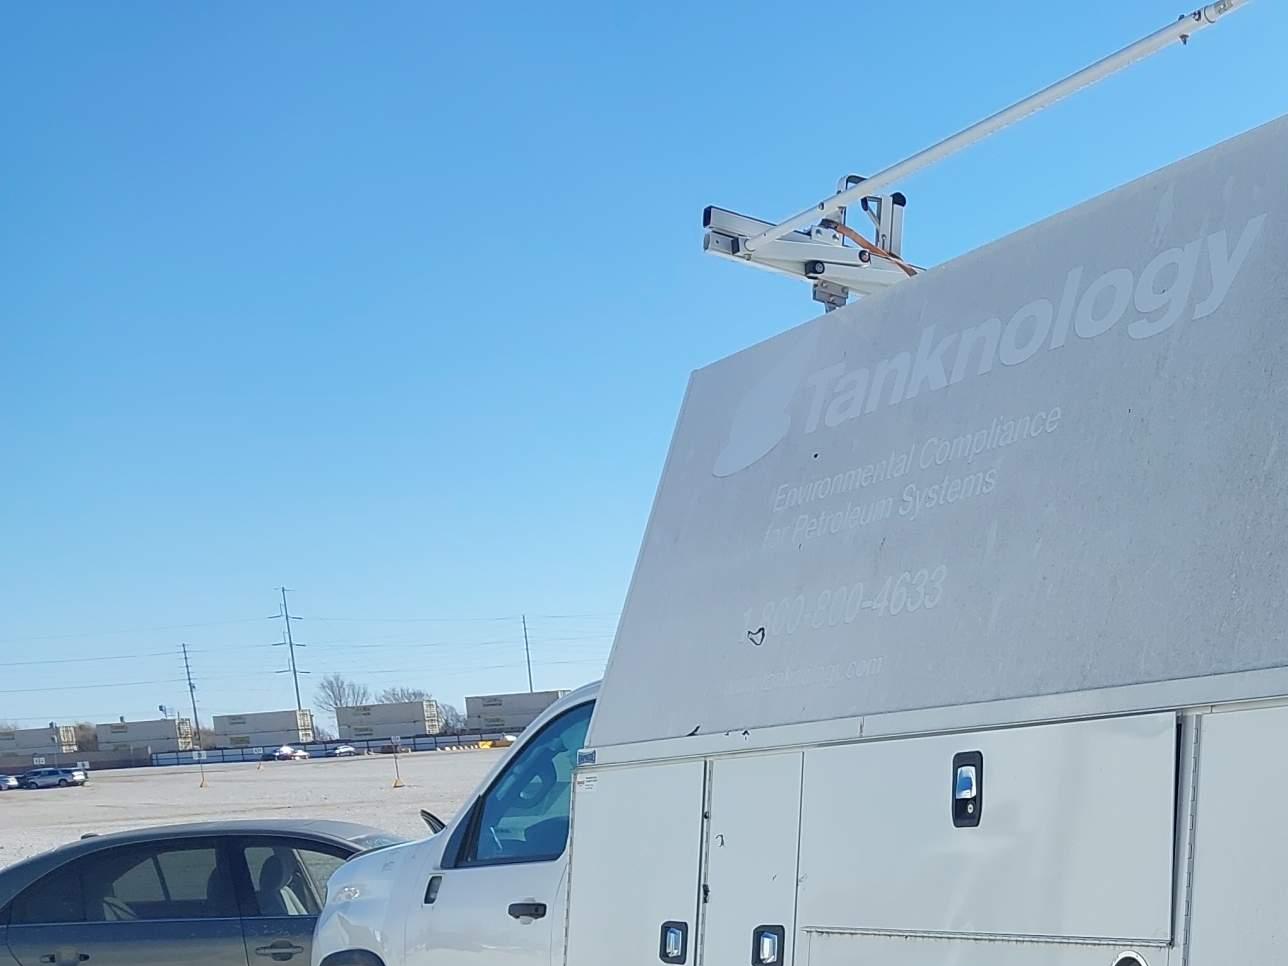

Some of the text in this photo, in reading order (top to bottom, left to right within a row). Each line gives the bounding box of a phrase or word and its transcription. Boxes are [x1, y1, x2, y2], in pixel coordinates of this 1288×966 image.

[801, 214, 1268, 435] Tanknology
[771, 405, 1063, 514] Environmental Compliance
[791, 495, 894, 544] Petroleum
[897, 466, 1001, 521] Systems
[740, 563, 949, 643] 1800-800-4633
